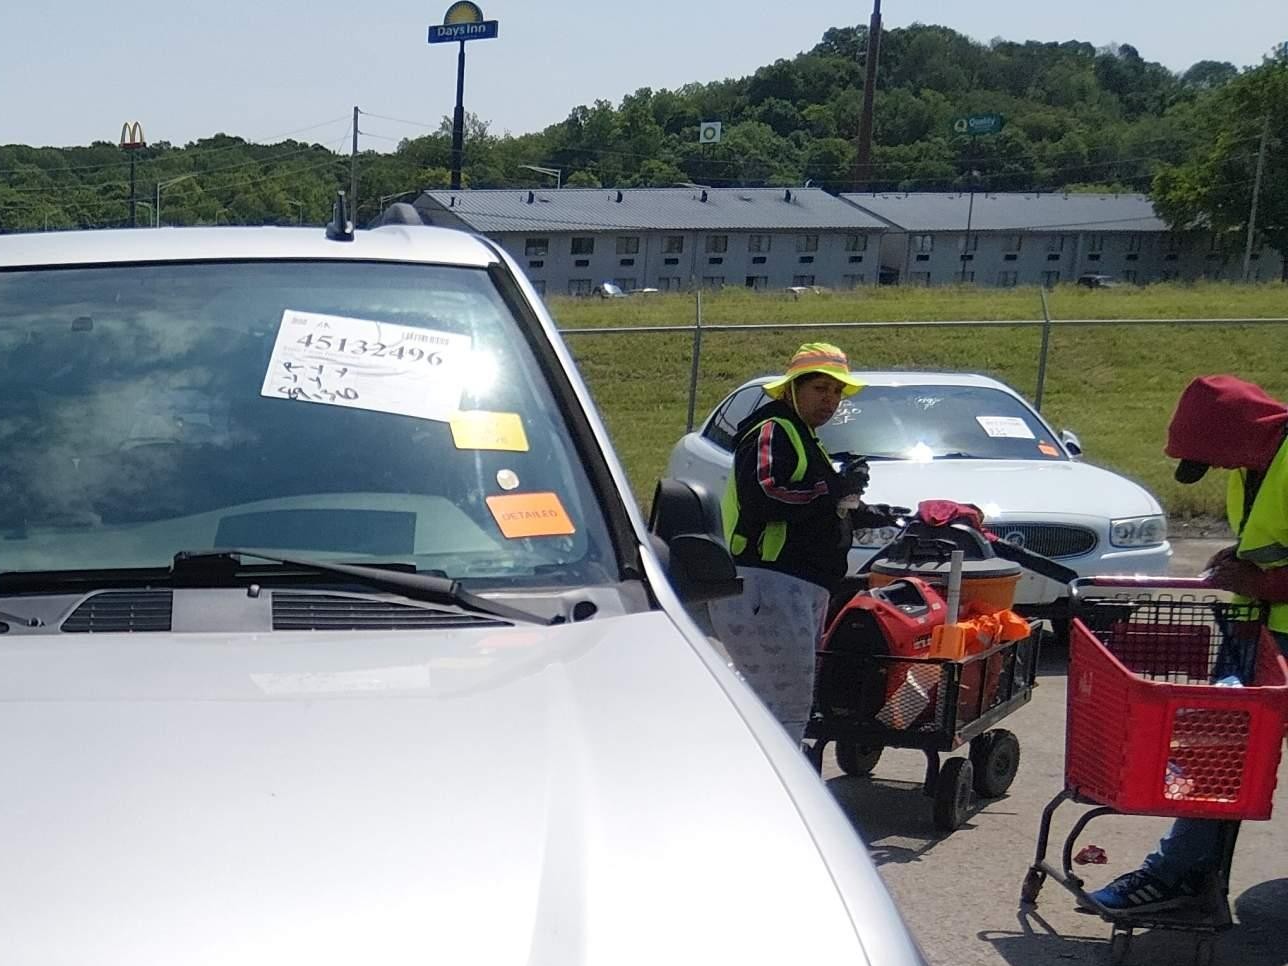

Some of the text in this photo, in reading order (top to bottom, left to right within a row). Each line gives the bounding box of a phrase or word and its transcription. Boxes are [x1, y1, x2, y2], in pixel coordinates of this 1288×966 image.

[437, 24, 487, 37] Days Inn
[296, 333, 443, 367] 45132496
